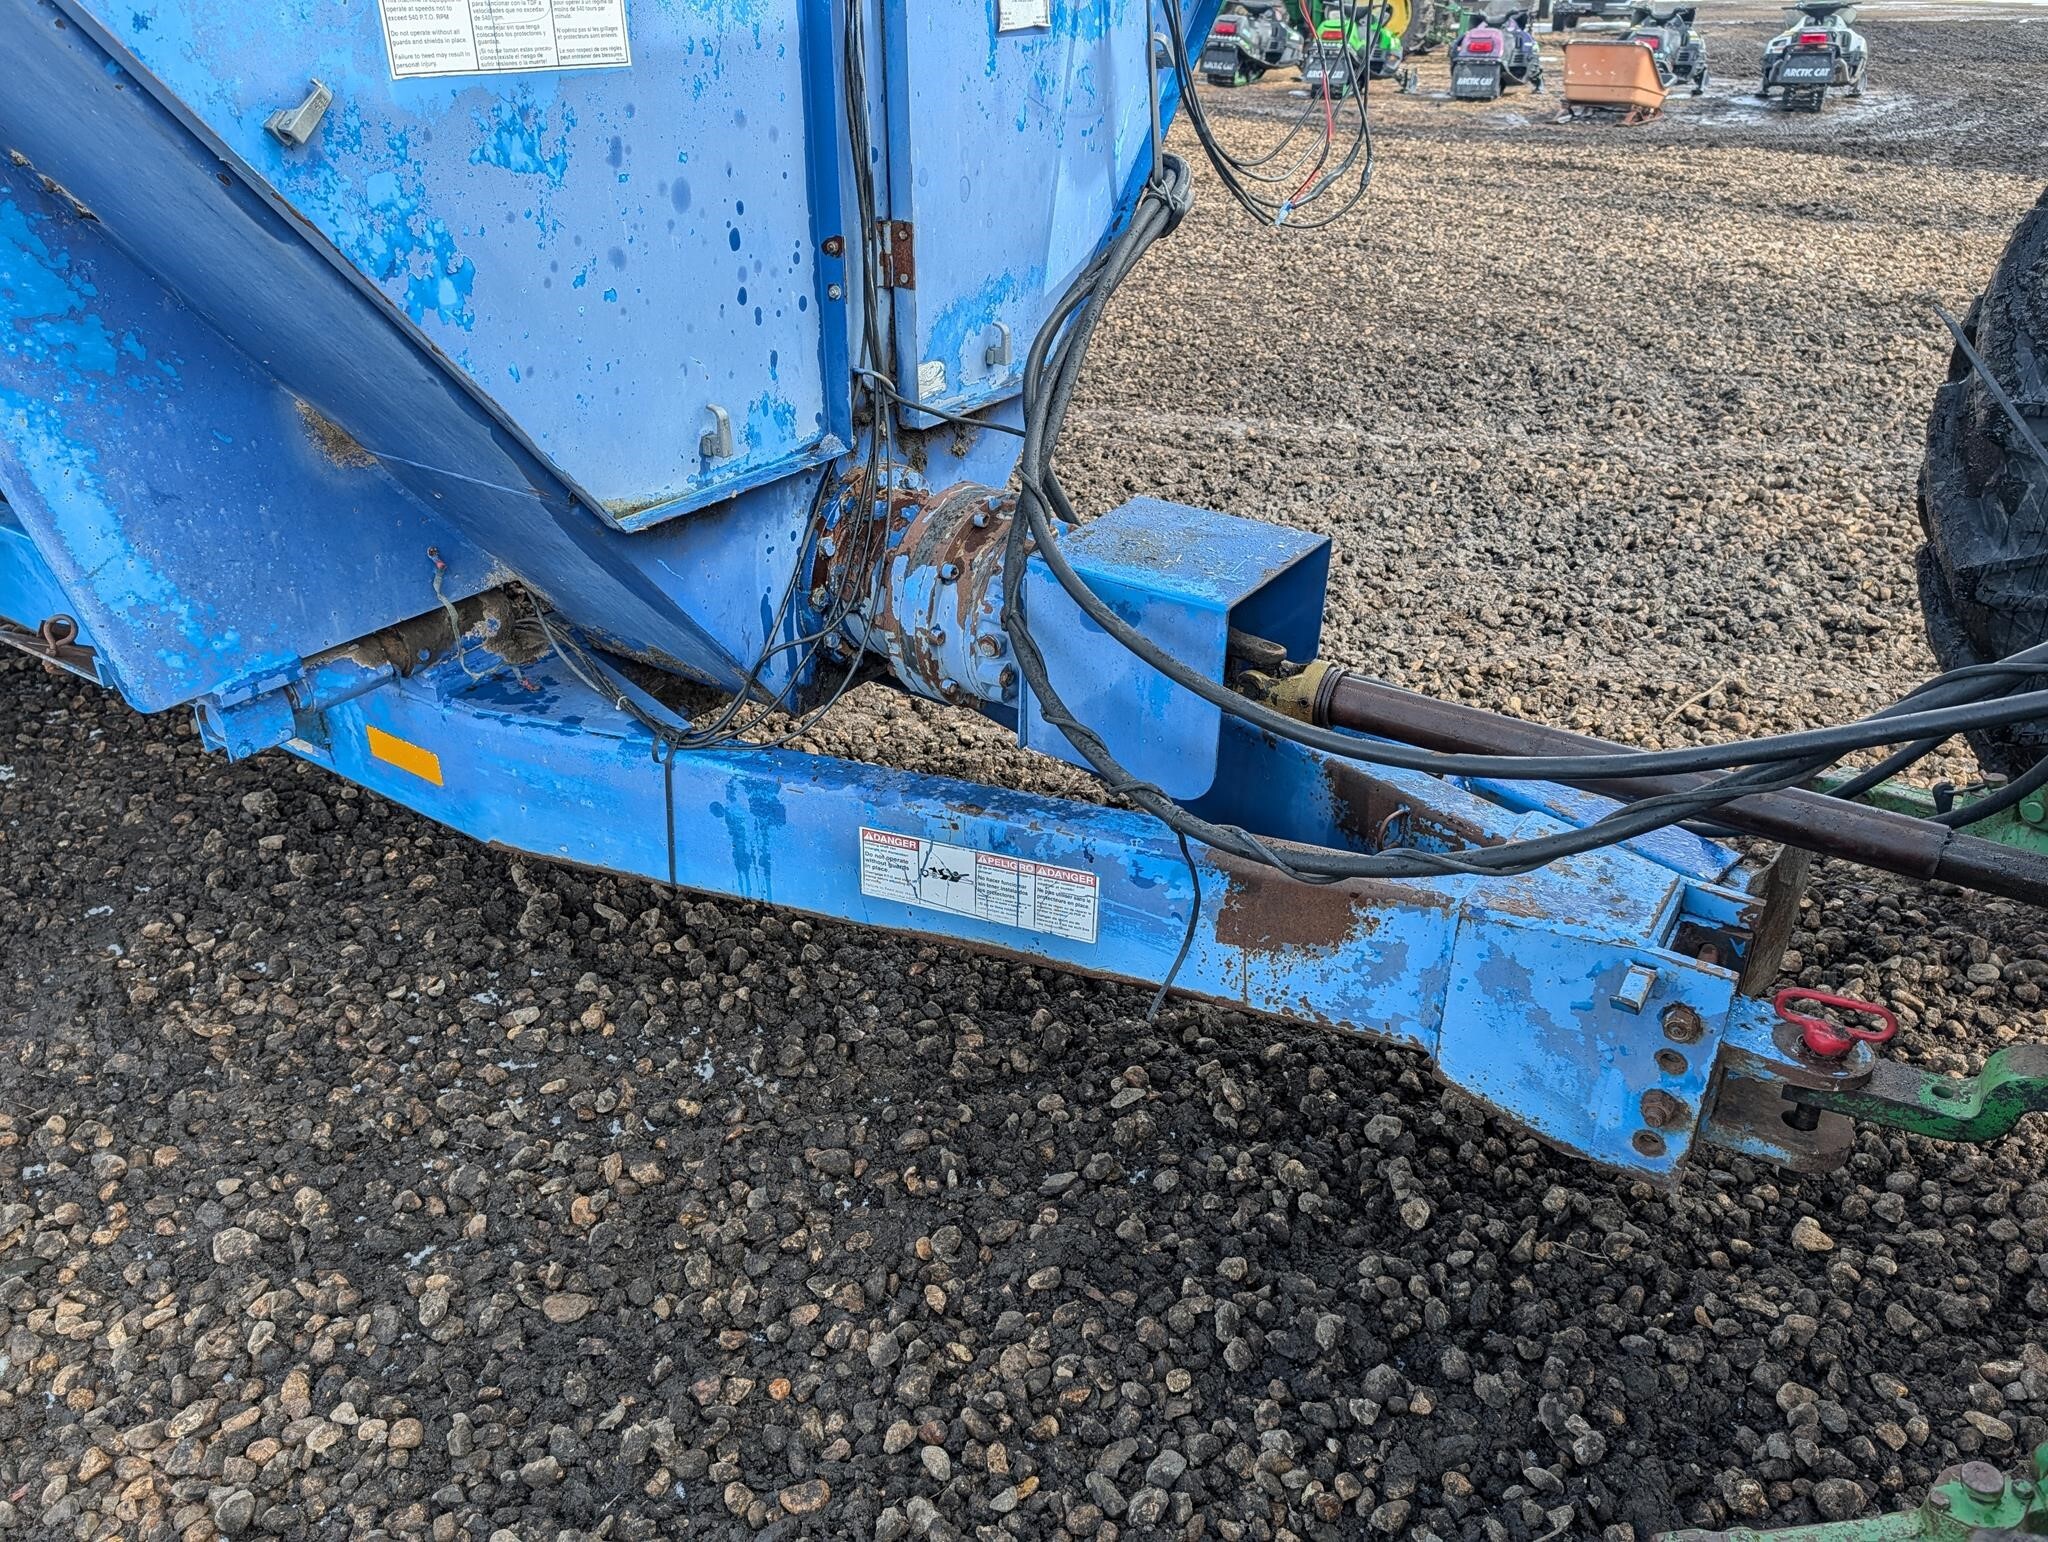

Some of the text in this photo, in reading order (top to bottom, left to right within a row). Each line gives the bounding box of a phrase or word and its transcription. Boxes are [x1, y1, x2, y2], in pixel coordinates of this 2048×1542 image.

[1783, 68, 1830, 77] ARCTIC CAT
[1456, 77, 1494, 86] ARCTIC CAT
[874, 833, 916, 848] DANGER
[865, 858, 886, 866] without
[886, 856, 909, 864] operate
[987, 857, 1033, 871] PELIGRO
[1048, 869, 1093, 885] DANGER
